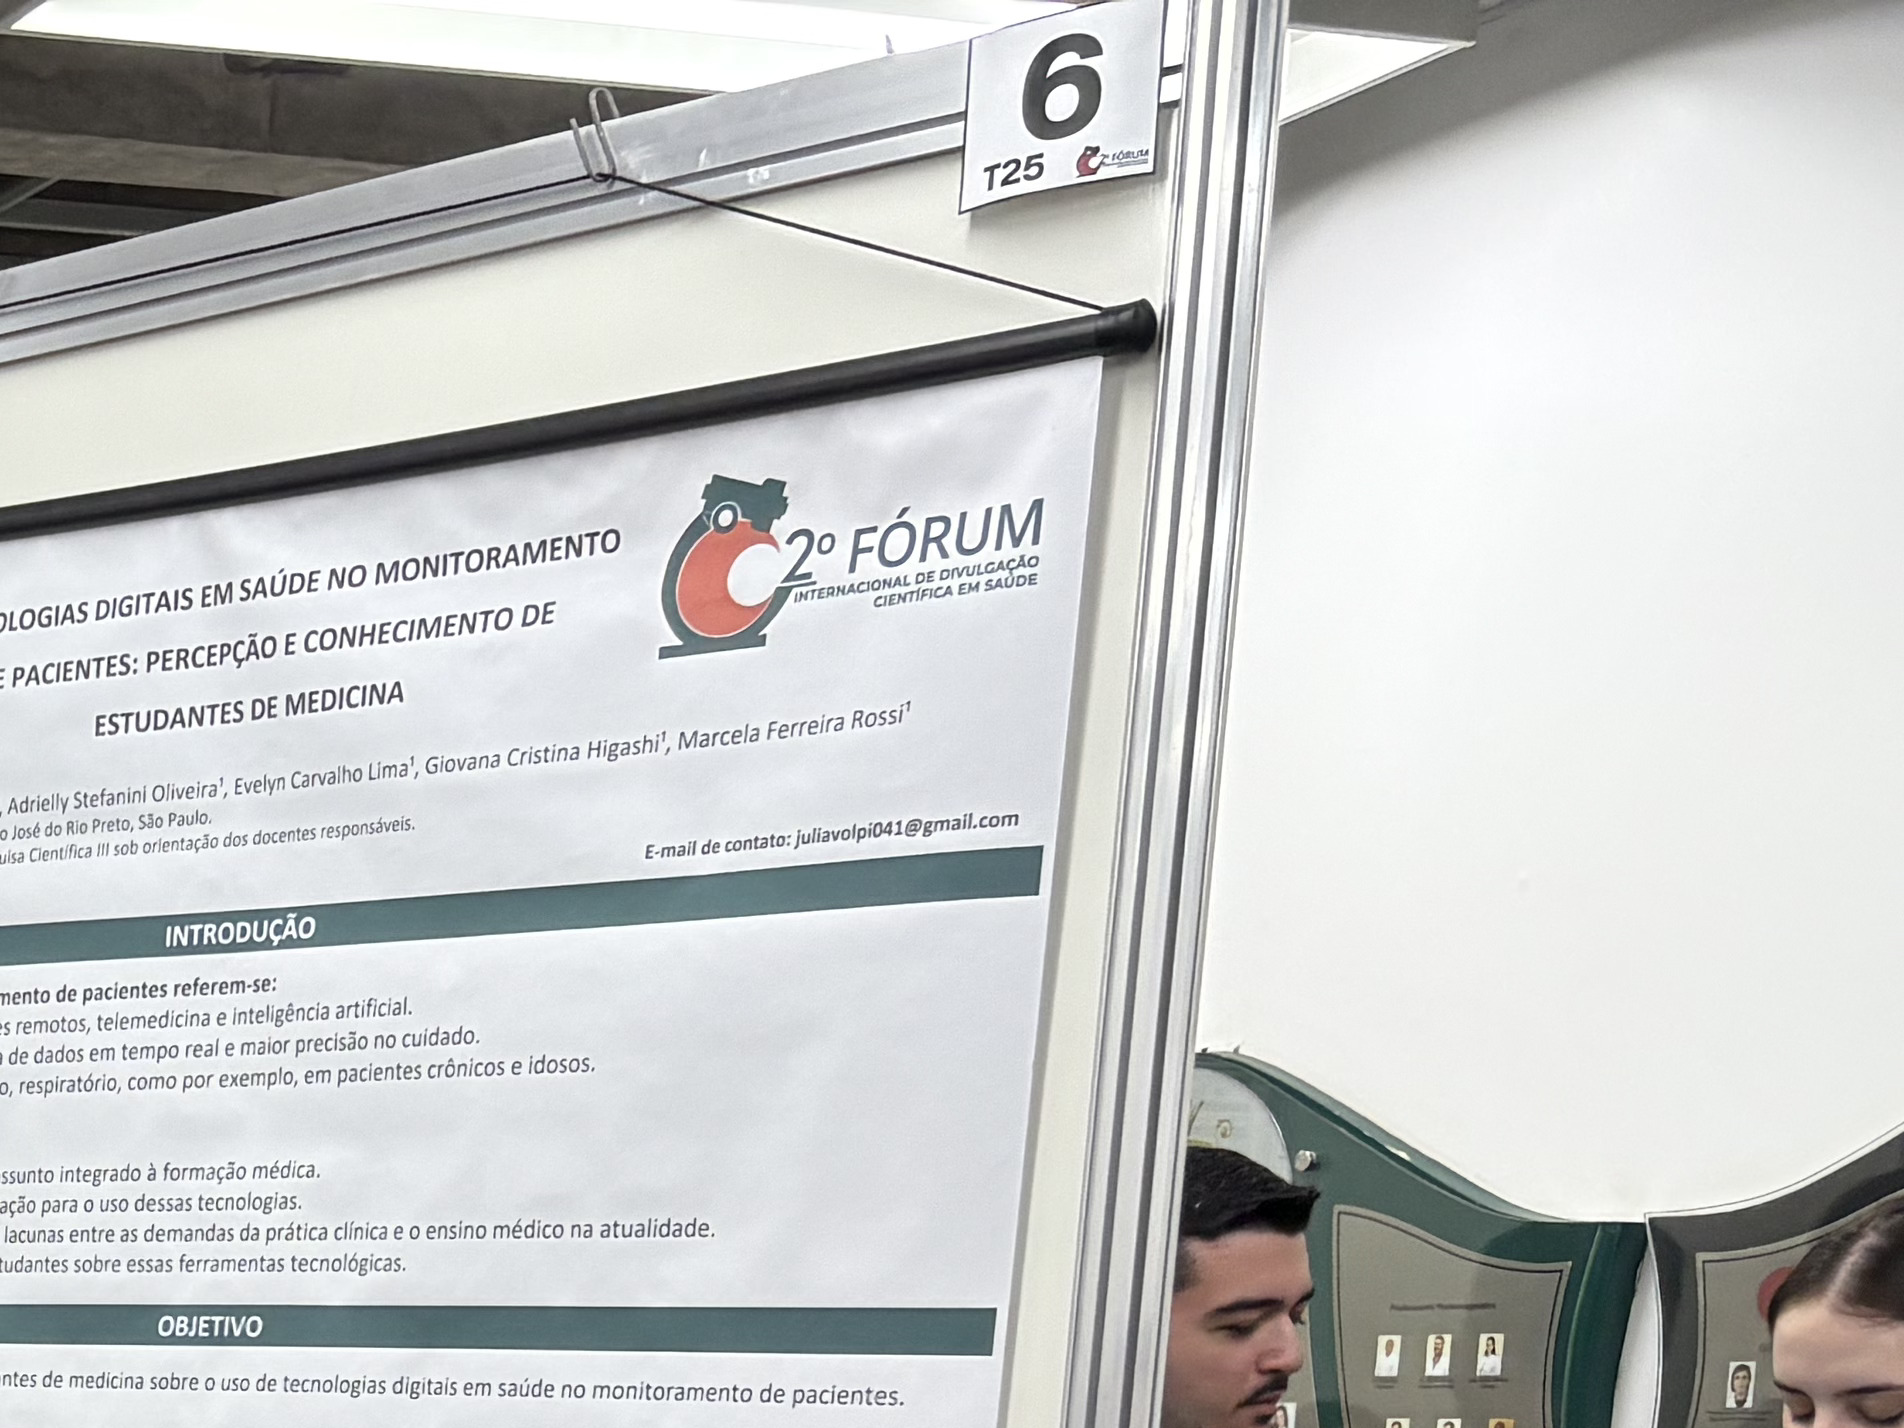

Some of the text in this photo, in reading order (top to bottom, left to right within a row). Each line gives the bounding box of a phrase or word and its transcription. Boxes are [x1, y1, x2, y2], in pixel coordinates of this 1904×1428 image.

[1022, 33, 1103, 140] 6
[983, 152, 1045, 191] T25
[848, 498, 1044, 574] FÓRUM
[94, 587, 194, 622] DIGITAIS
[200, 581, 233, 609] EM
[239, 567, 322, 602] SAÚDE
[327, 564, 368, 591] NO
[374, 528, 621, 586] MONITORAMENTO
[795, 555, 1040, 603] INTERNACIONAL DE DIVULGAÇÃO
[873, 572, 1039, 608] CIENTÍFICA EM SAÚDE
[11, 653, 138, 689] PACIENTES:
[146, 632, 278, 674] PERCEPÇÃO
[284, 632, 297, 656] E
[303, 606, 514, 654] CONHECIMENTO
[520, 600, 557, 628] DE
[94, 680, 404, 737] ESTUDANTES DE MEDICINA
[165, 912, 317, 948] INTRODUÇÃO
[157, 1315, 264, 1338] OBJETIVO
